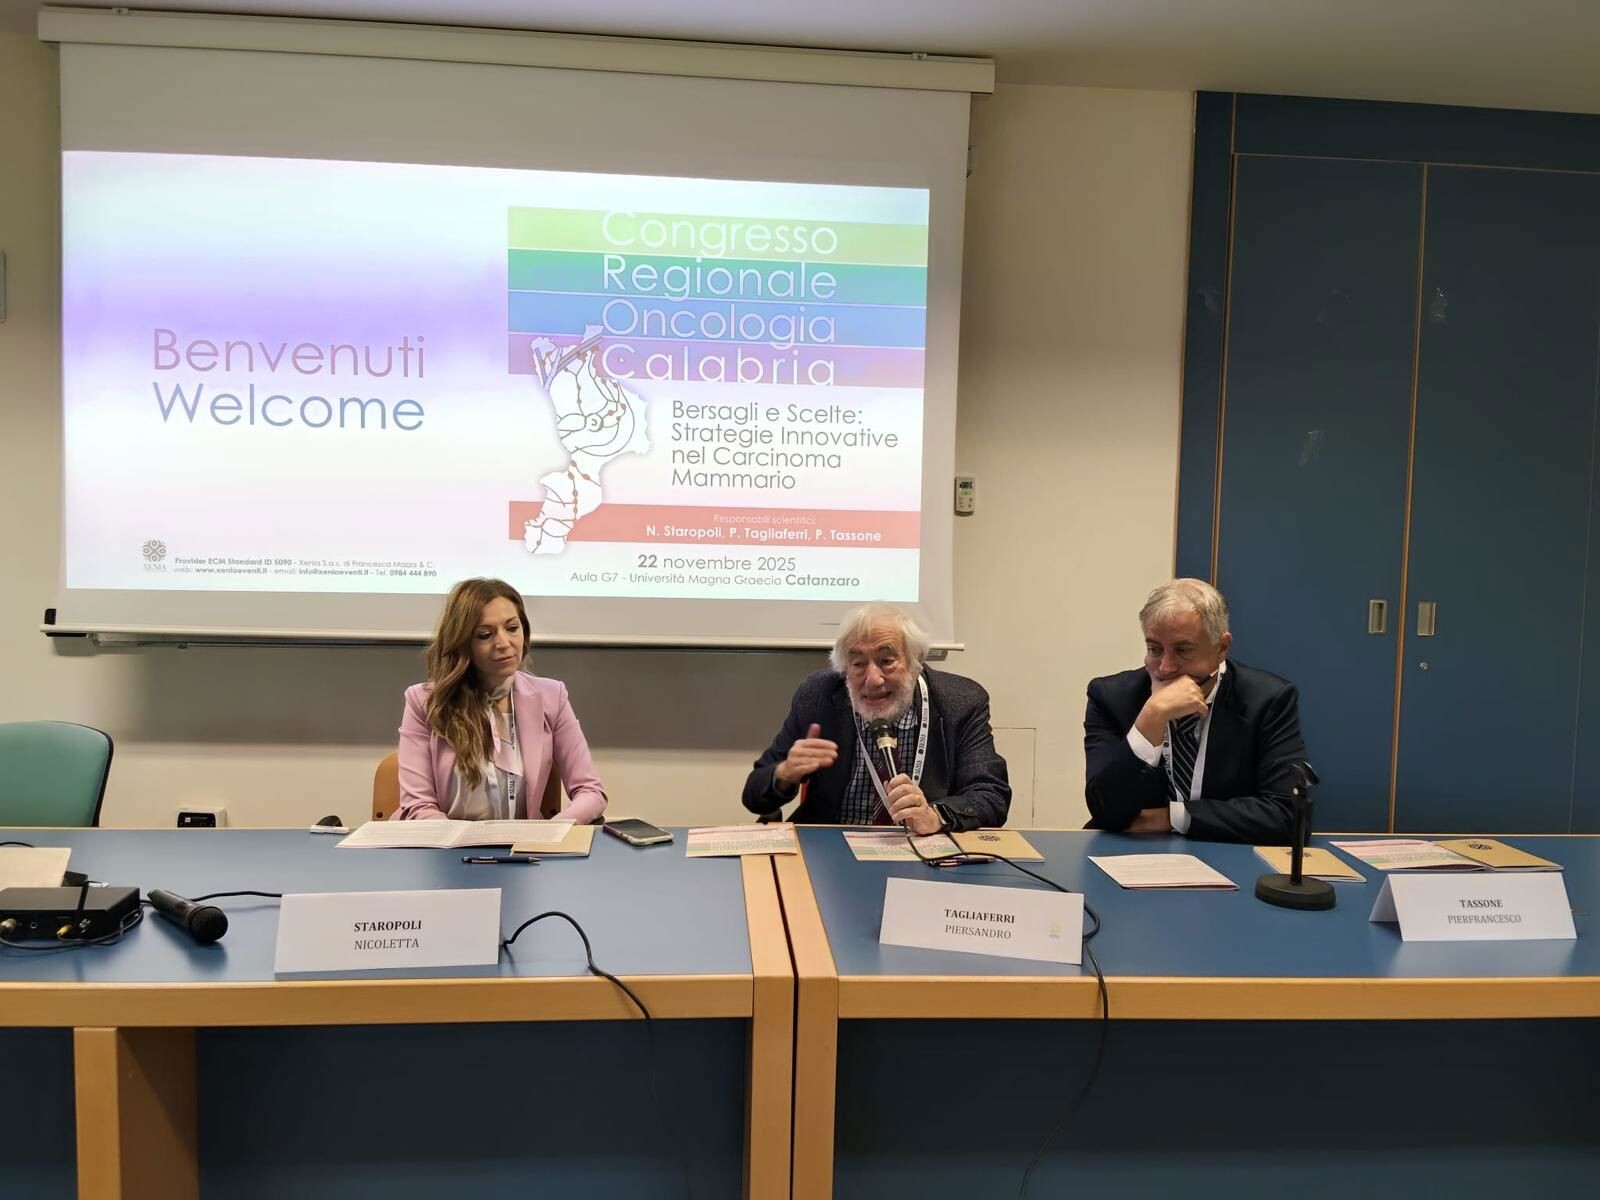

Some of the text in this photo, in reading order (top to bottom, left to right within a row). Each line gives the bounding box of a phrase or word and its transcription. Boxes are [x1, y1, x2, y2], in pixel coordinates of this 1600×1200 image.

[602, 209, 838, 258] Congresso
[602, 253, 838, 302] Regionale
[601, 298, 836, 349] Oncologia
[153, 327, 425, 378] Benvenuti
[601, 343, 835, 386] Calabria
[152, 381, 425, 431] Welcome
[671, 400, 863, 426] Bersagli e Scelte:
[671, 423, 898, 449] Strategie Innovative
[671, 446, 842, 469] nel Carcinoma
[671, 469, 796, 490] Mammario
[713, 513, 817, 526] Responsabili scientifici:
[646, 525, 881, 542] N. Staropoli, P. Tagliaferri, P. Tassone
[174, 557, 206, 565] Provider
[208, 557, 226, 565] ECM
[228, 558, 262, 566] Standard
[264, 558, 272, 566] ID
[637, 554, 796, 571] 22 novembre 2025
[570, 571, 598, 583] Aula
[601, 572, 619, 584] G7
[629, 571, 685, 585] Università
[688, 574, 731, 588] Magna
[734, 574, 782, 586] Graecia
[785, 573, 860, 587] Catanzaro
[1459, 899, 1504, 908] TASSONE
[943, 908, 1015, 924] TAGLIAFERRI
[1447, 914, 1522, 924] PIERFRANCESCO
[353, 920, 422, 932] STAROPOLI
[944, 924, 1012, 940] PIERSANDRO
[354, 938, 420, 950] NICOLETTA
